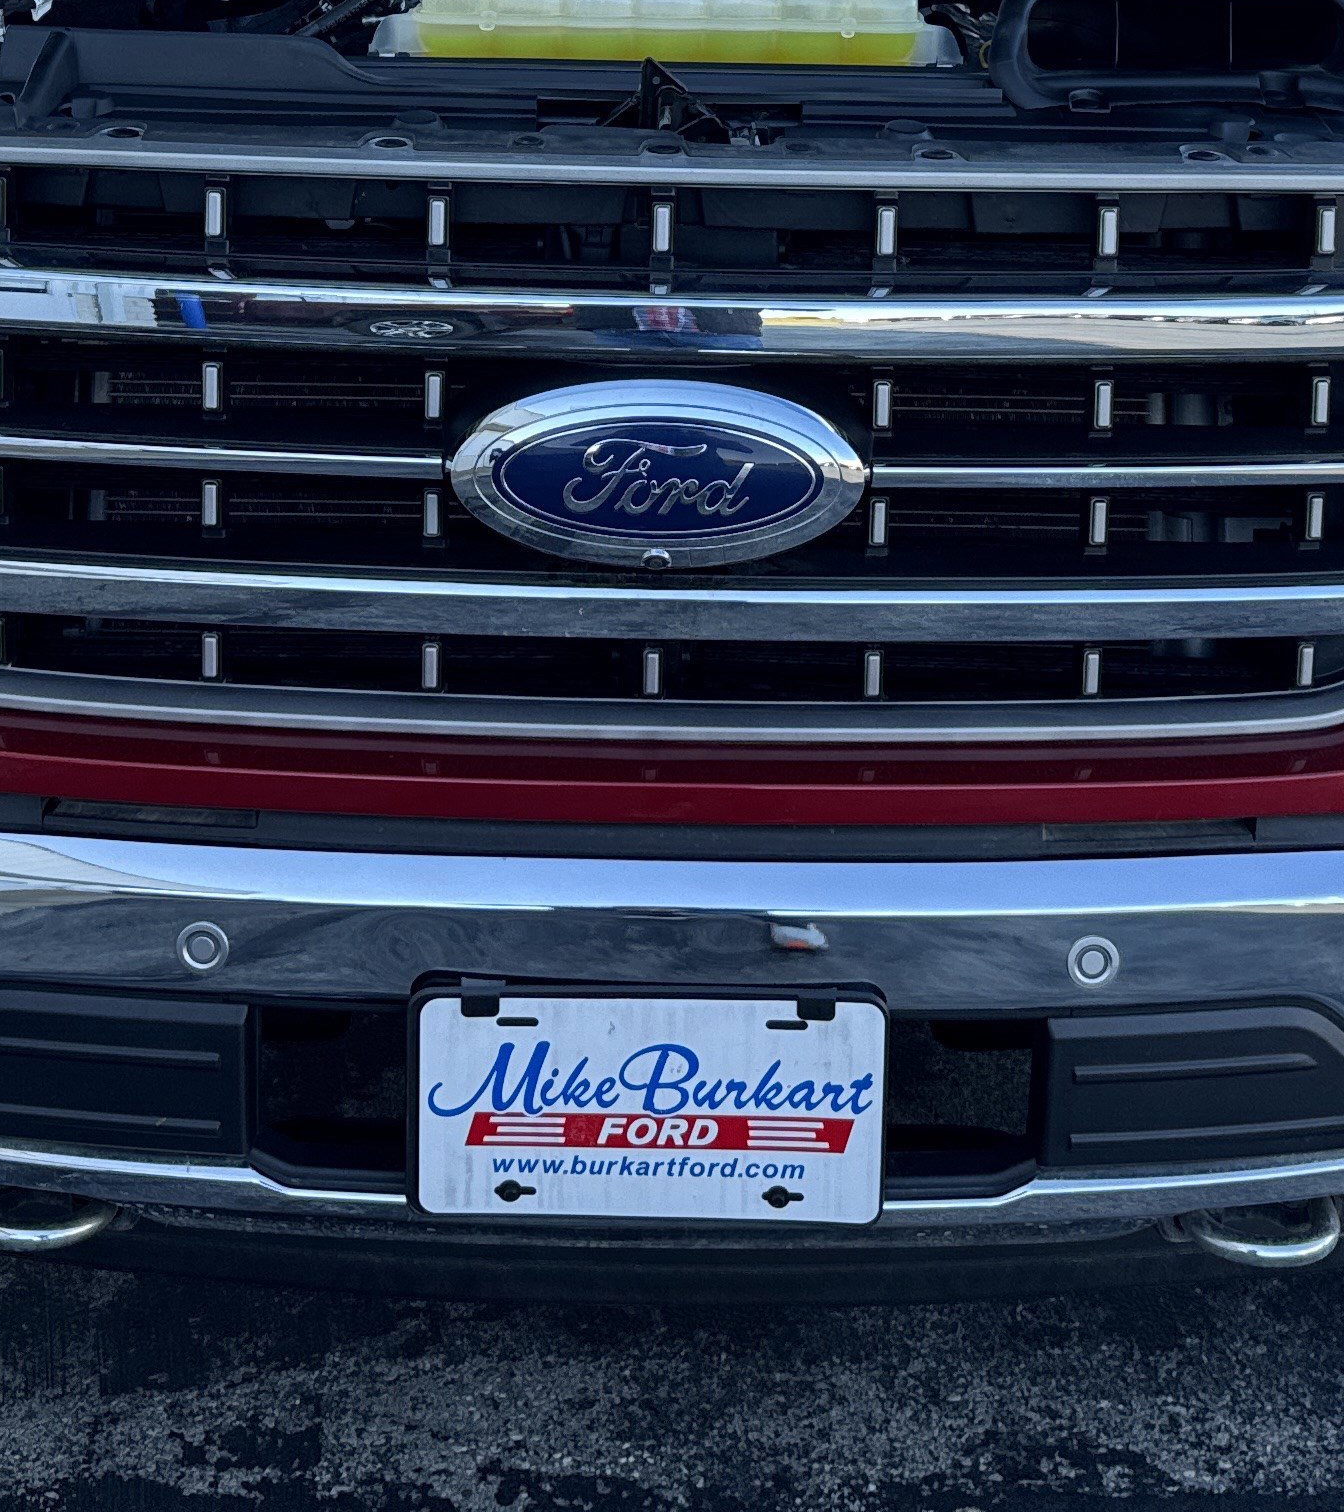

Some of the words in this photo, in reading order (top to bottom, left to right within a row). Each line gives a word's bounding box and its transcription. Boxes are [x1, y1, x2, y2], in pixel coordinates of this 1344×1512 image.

[563, 438, 754, 517] Ford
[427, 1040, 621, 1117] Mike
[619, 1042, 874, 1115] Burkart
[597, 1117, 719, 1147] FORD
[492, 1155, 805, 1180] www.burkartford.com
